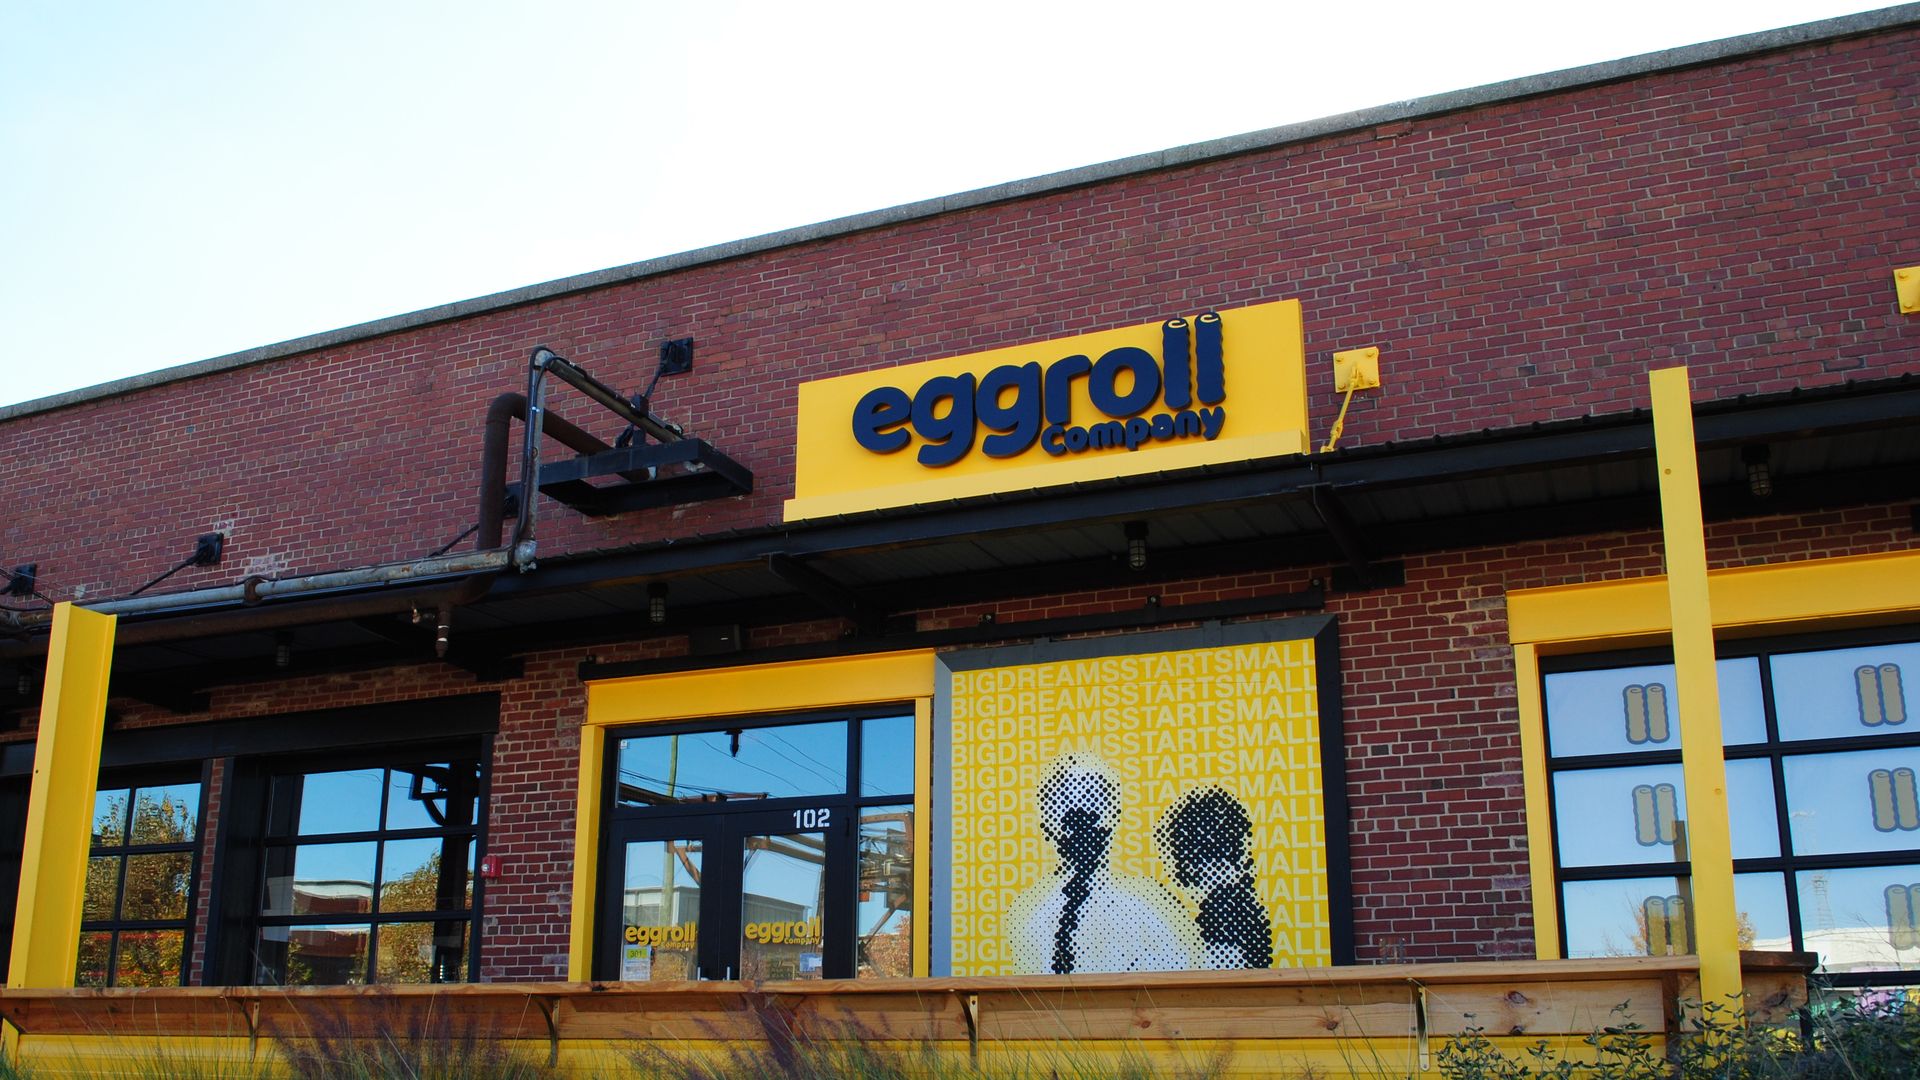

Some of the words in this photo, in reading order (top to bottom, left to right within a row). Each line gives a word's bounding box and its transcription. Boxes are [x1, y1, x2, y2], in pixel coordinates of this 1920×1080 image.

[851, 311, 1226, 468] eggroll
[1041, 404, 1225, 457] company
[793, 808, 830, 828] 102
[625, 921, 697, 947] eggroll
[745, 915, 821, 944] eggroll
